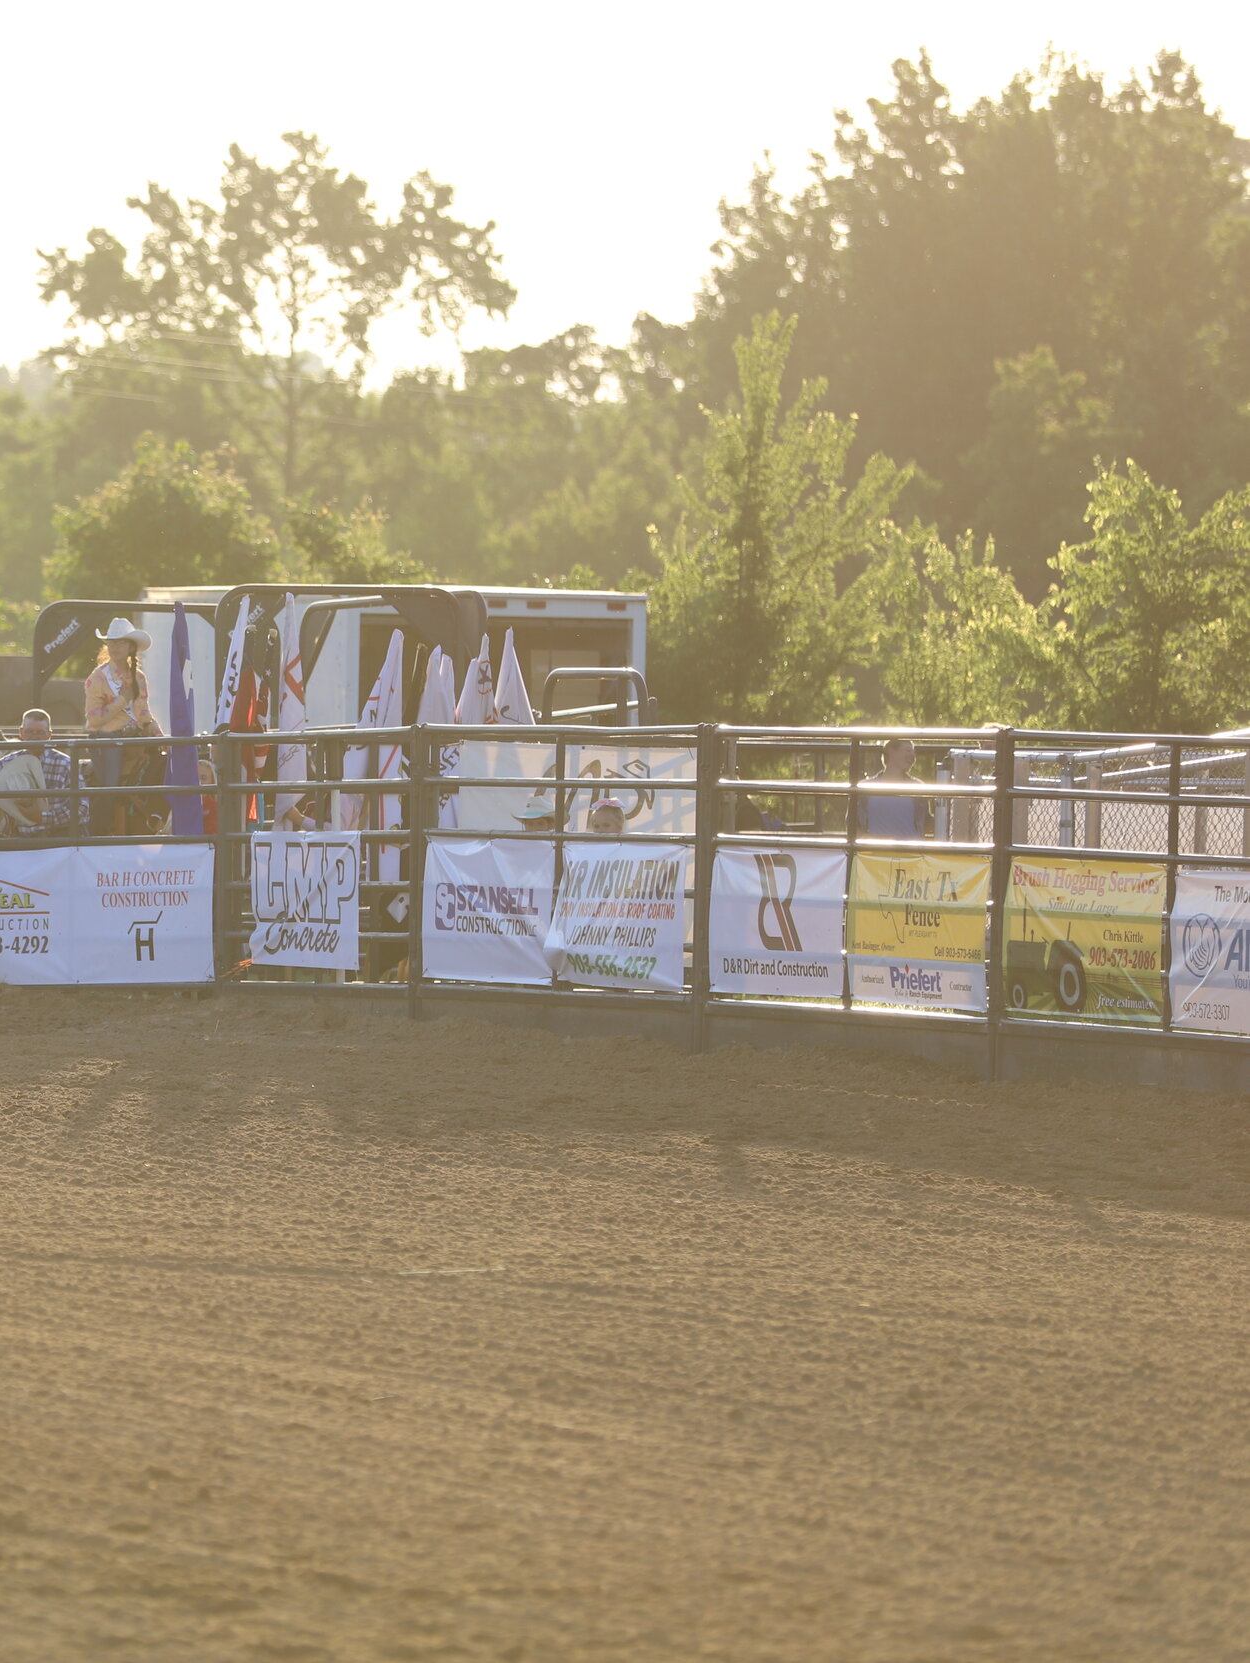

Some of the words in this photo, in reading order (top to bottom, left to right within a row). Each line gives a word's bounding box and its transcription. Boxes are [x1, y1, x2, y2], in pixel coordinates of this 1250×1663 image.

[96, 872, 119, 887] BAR
[122, 872, 131, 887] H
[133, 870, 195, 886] CONCRETE
[586, 860, 680, 900] INSULATION
[893, 868, 930, 900] East
[1013, 865, 1050, 887] Brush
[1053, 867, 1106, 896] Hogging
[1108, 870, 1159, 895] Services
[102, 891, 188, 908] CONSTRUCTION
[456, 885, 538, 915] STANSELL
[1215, 885, 1231, 902] The
[626, 902, 646, 919] ROOF
[647, 903, 676, 920] COATING
[904, 903, 941, 927] Fence
[1047, 897, 1075, 912] Small
[1076, 902, 1086, 912] or
[1090, 900, 1118, 918] Large
[264, 911, 340, 954] Concrete
[456, 915, 528, 936] CONSTRUCTION
[567, 925, 612, 946] JOHNNY
[612, 926, 657, 948] PHILLIPS
[1103, 929, 1122, 942] Chris
[1124, 930, 1144, 943] Kittle
[744, 958, 759, 975] Dirt
[760, 960, 776, 976] and
[777, 960, 829, 978] Construction
[1089, 947, 1156, 970] 903-573-2086
[889, 965, 942, 992] Priefert
[1096, 994, 1115, 1009] free
